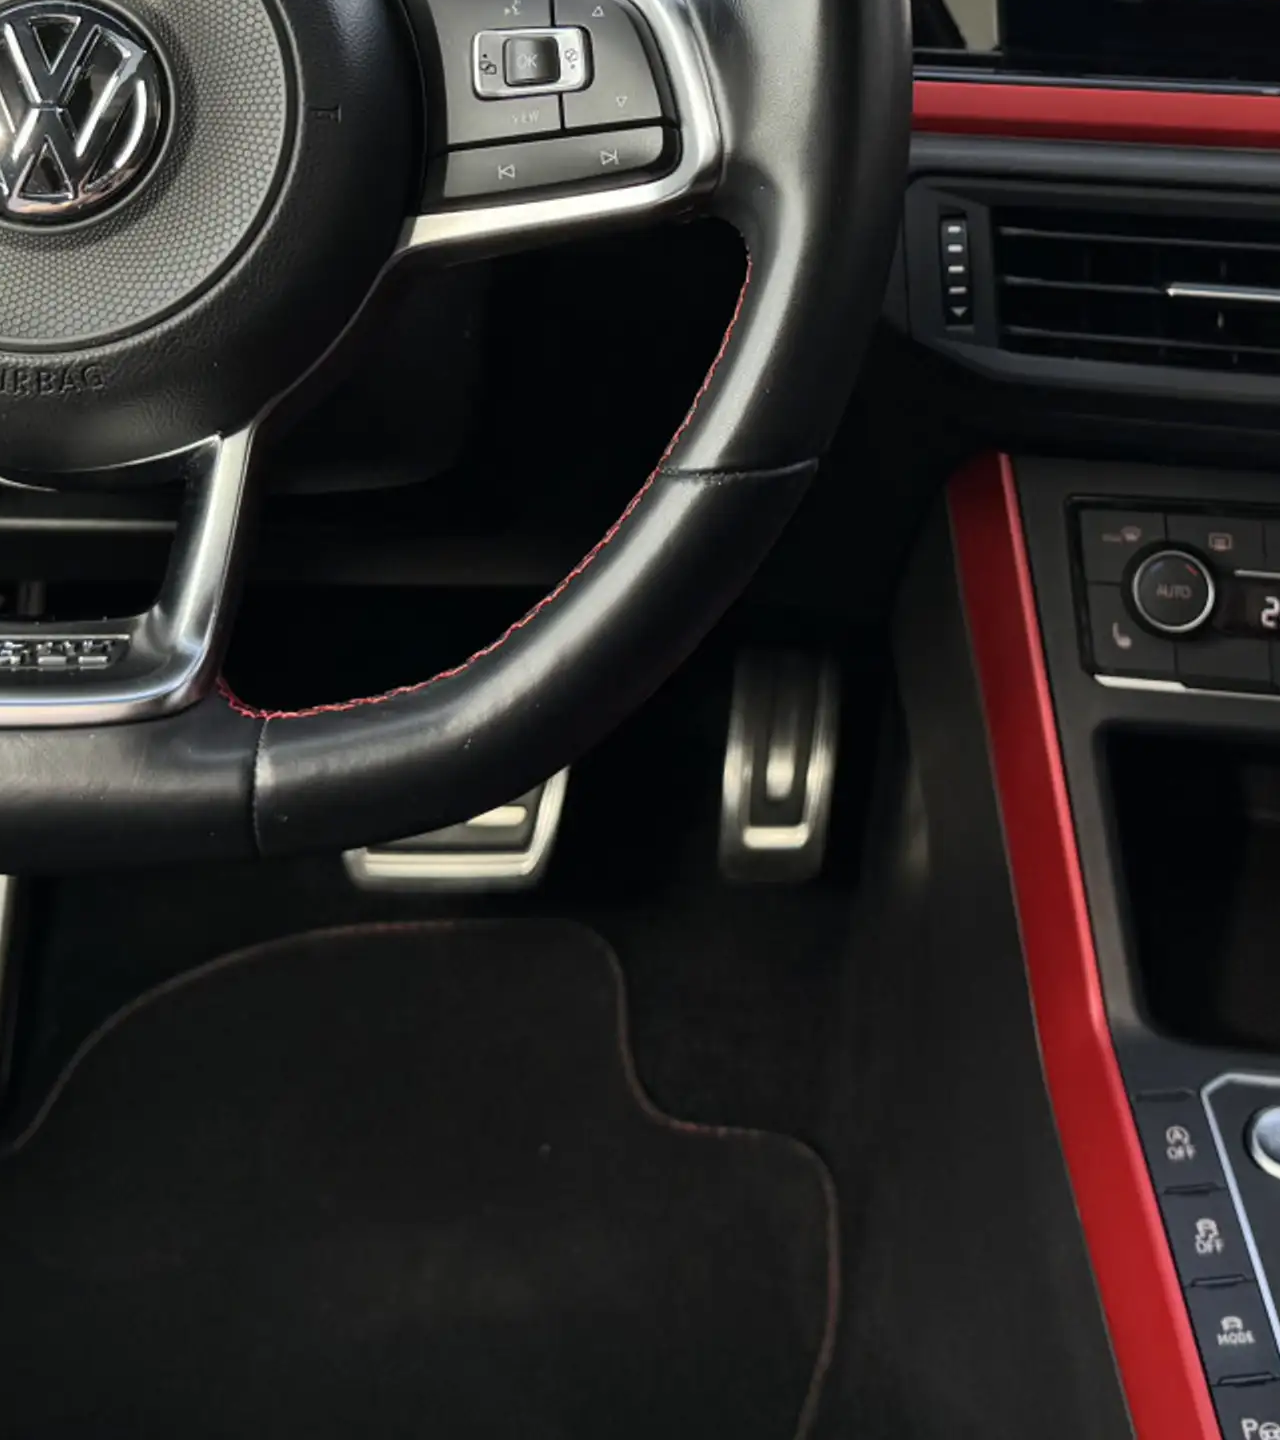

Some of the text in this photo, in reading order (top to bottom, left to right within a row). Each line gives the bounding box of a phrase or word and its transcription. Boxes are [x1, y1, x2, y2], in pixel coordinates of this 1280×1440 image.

[517, 54, 538, 68] OK
[1156, 584, 1193, 600] AUTO
[1167, 1145, 1196, 1161] OFF
[1195, 1239, 1224, 1255] OFF
[1217, 1330, 1256, 1346] MODE
[1241, 1418, 1260, 1440] P
